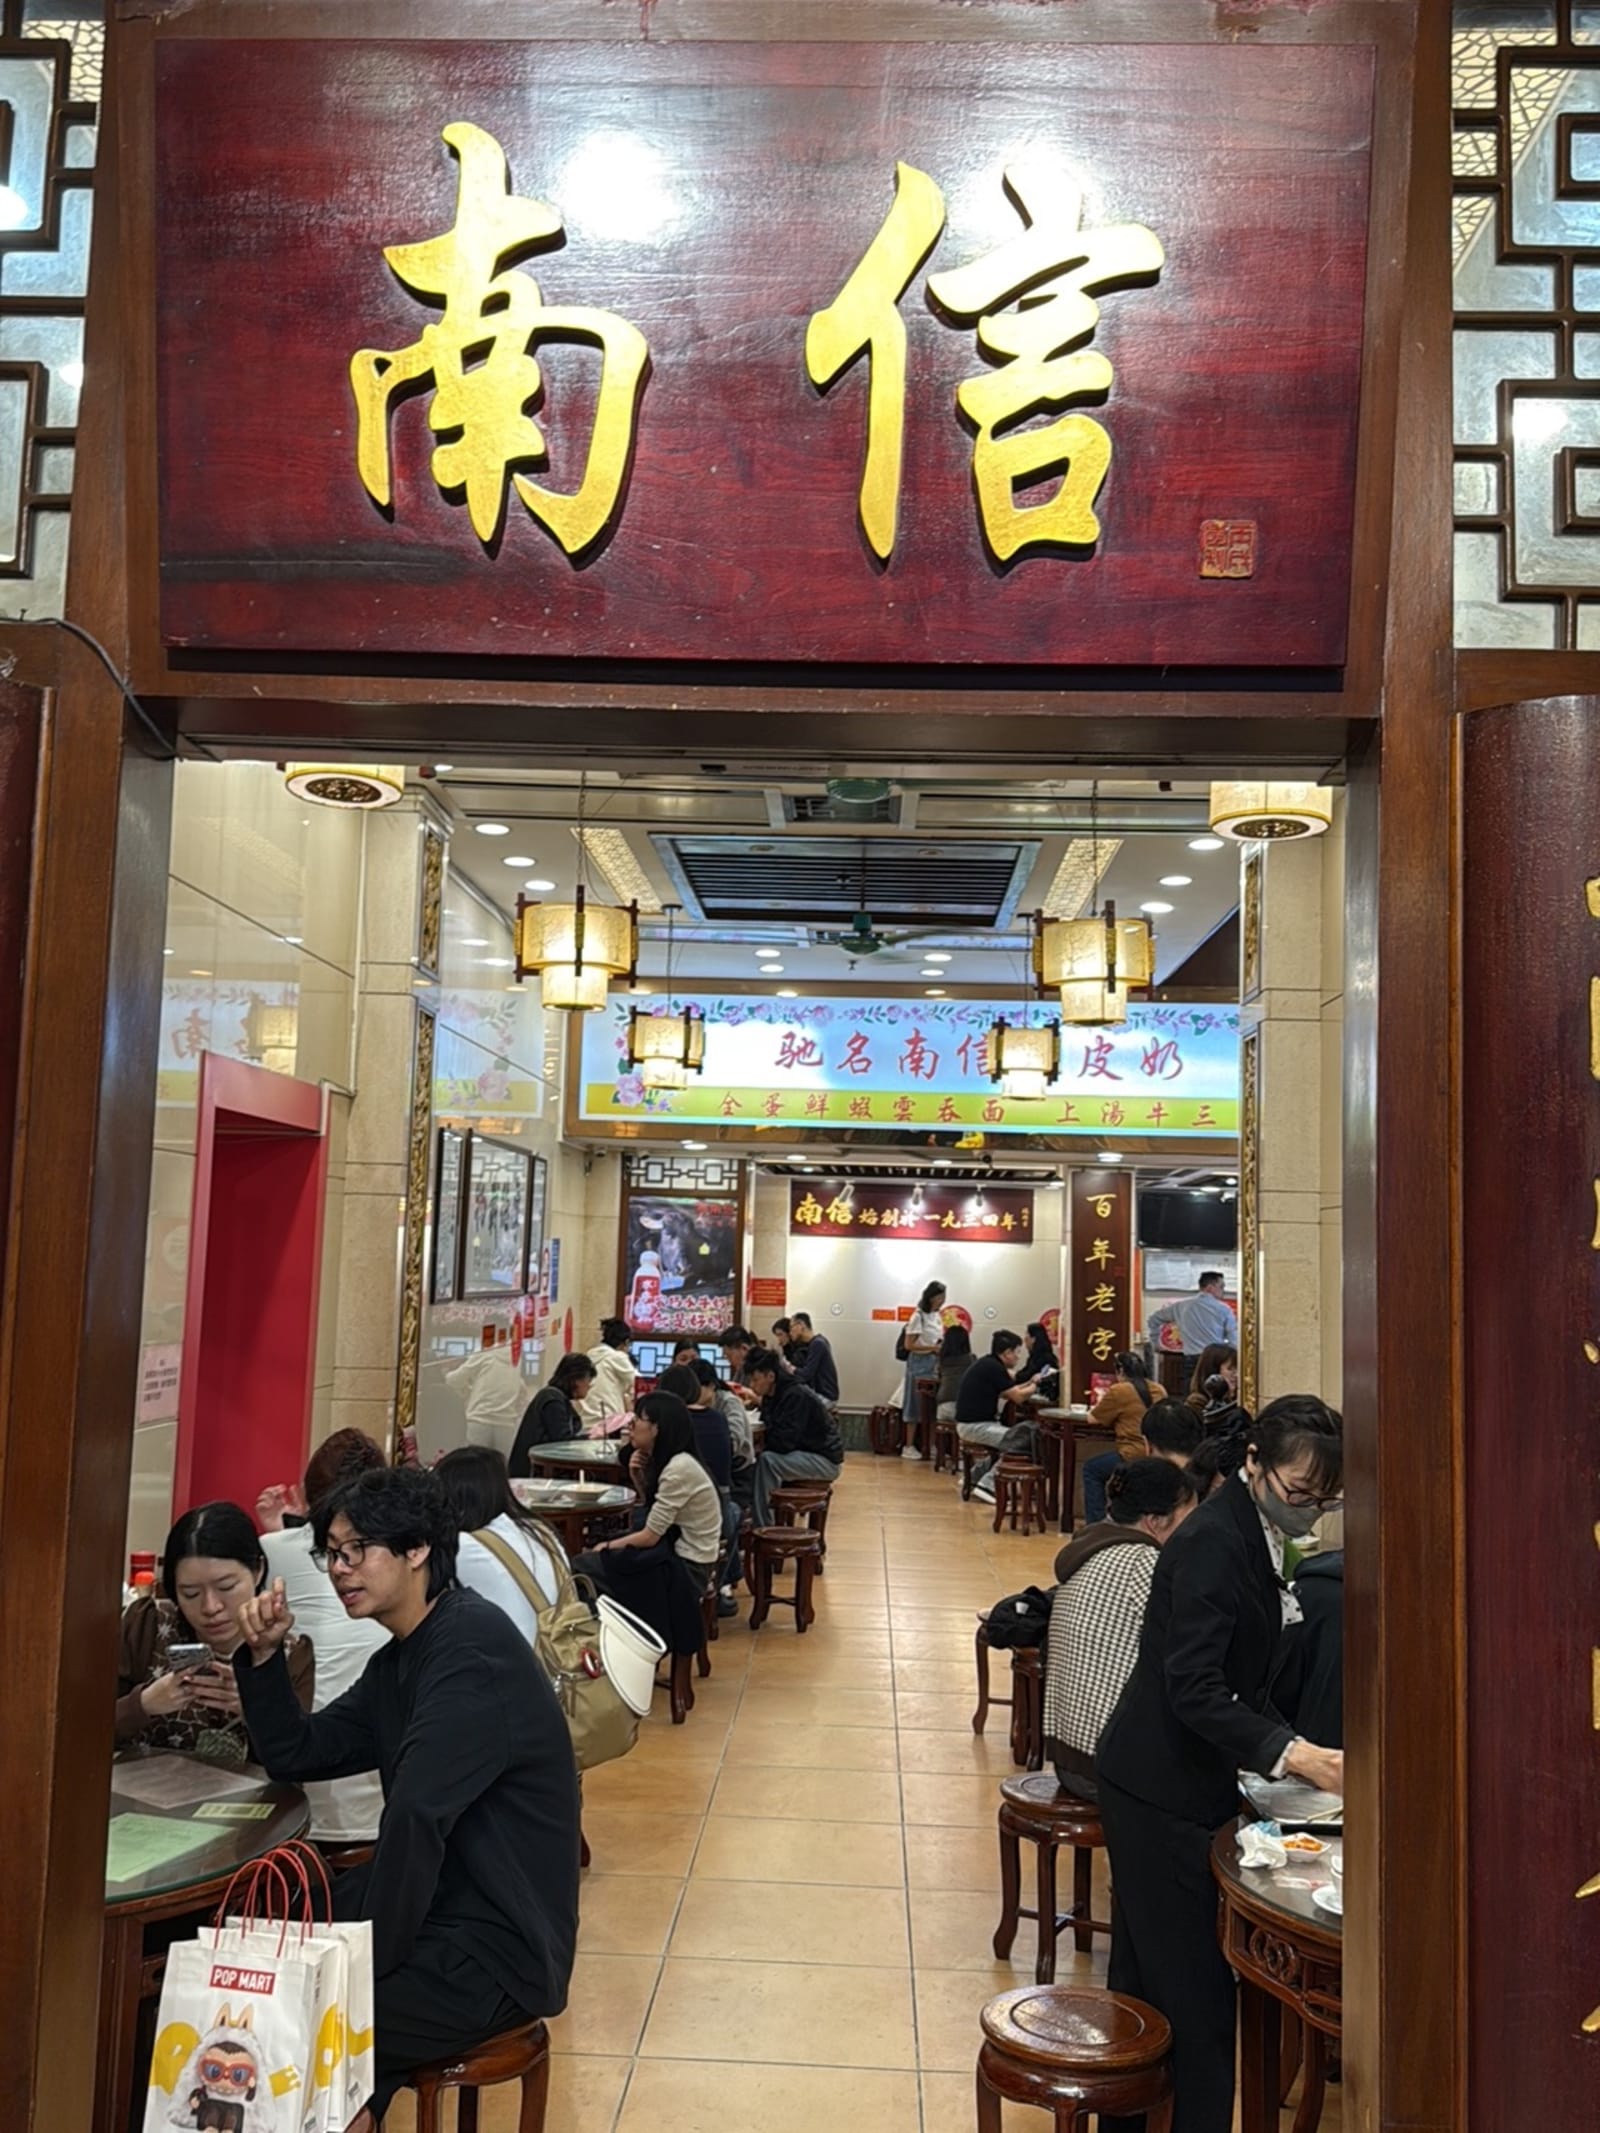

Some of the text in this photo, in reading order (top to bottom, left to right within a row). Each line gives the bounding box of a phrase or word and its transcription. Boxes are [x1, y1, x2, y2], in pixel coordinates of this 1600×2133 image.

[348, 120, 1166, 564] 南信
[774, 1027, 1183, 1080] 驰名南信皮奶
[1084, 1193, 1117, 1394] 百年老字
[212, 1968, 273, 1992] POP MART
